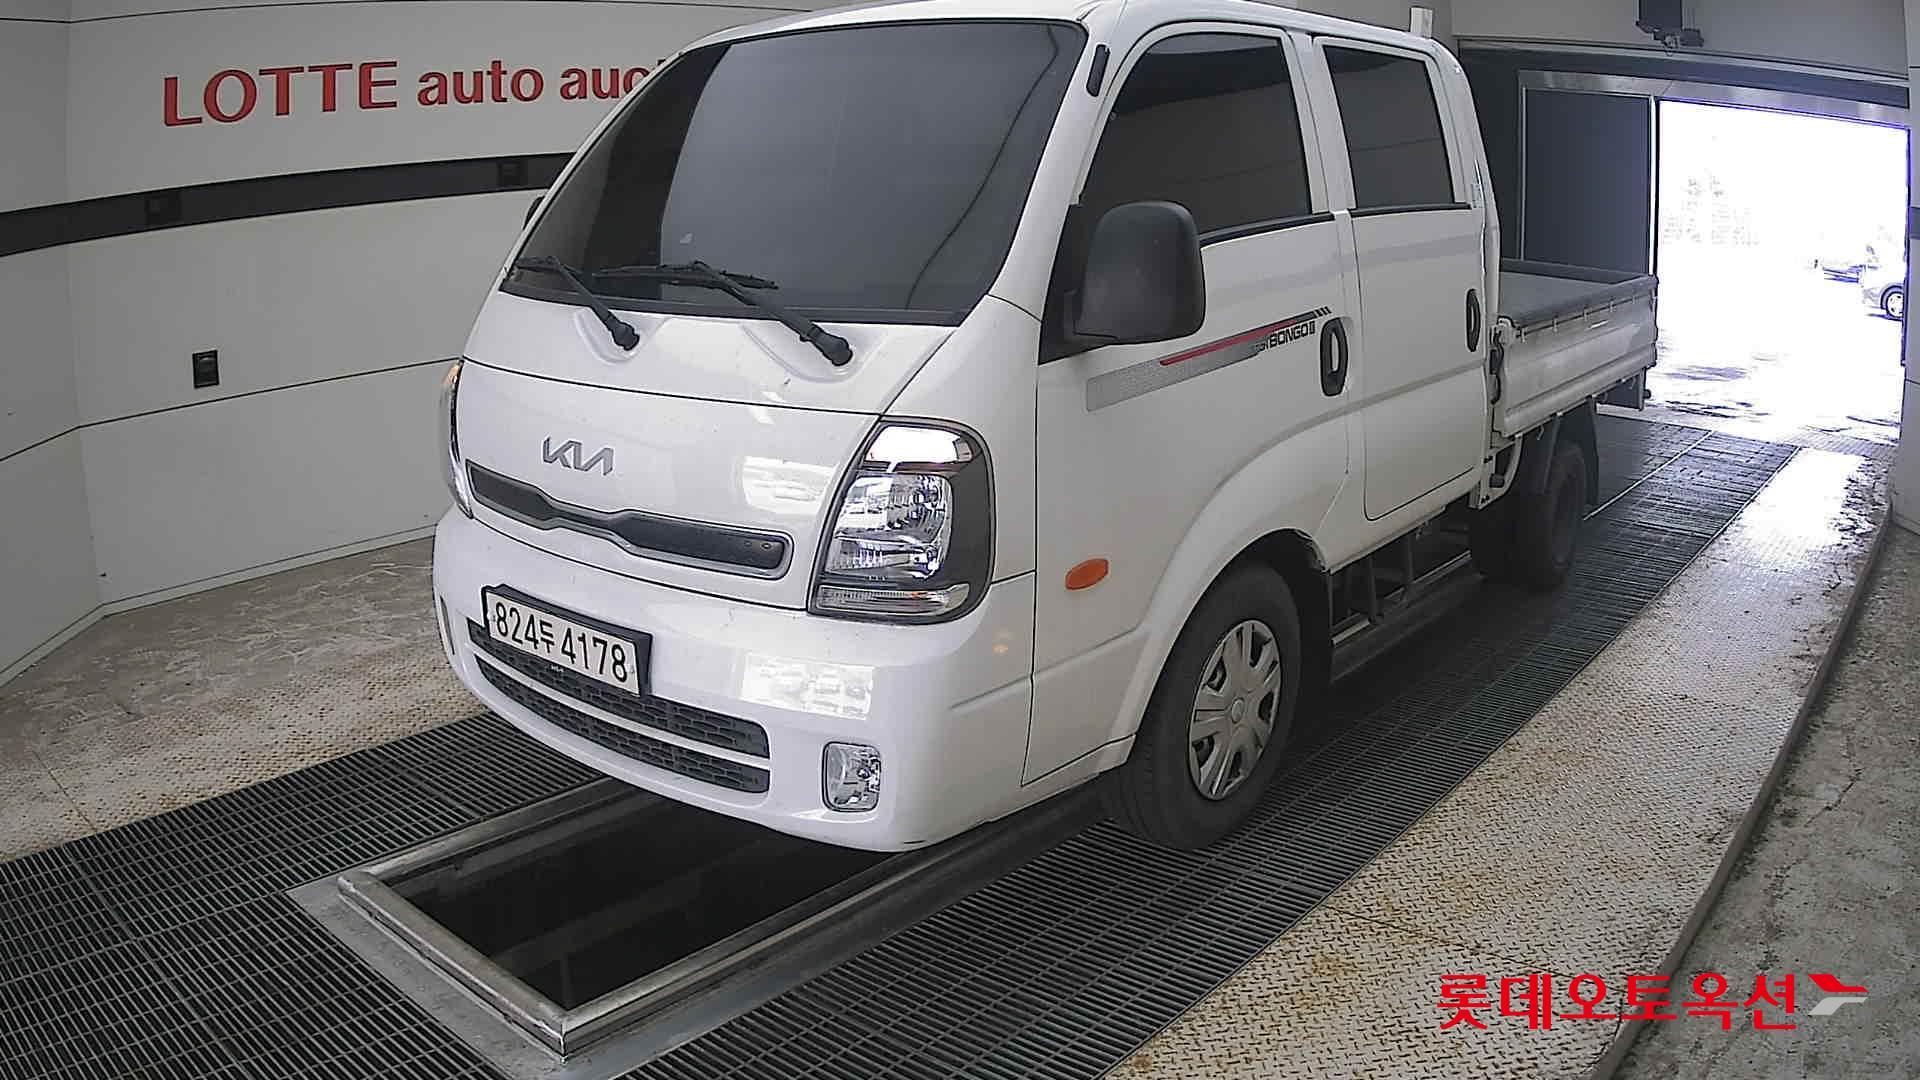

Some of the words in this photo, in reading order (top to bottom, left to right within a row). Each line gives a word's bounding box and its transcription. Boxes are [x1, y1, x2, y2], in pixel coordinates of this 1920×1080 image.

[164, 60, 398, 127] LOTTE
[417, 60, 544, 105] auto
[560, 59, 666, 100] auc
